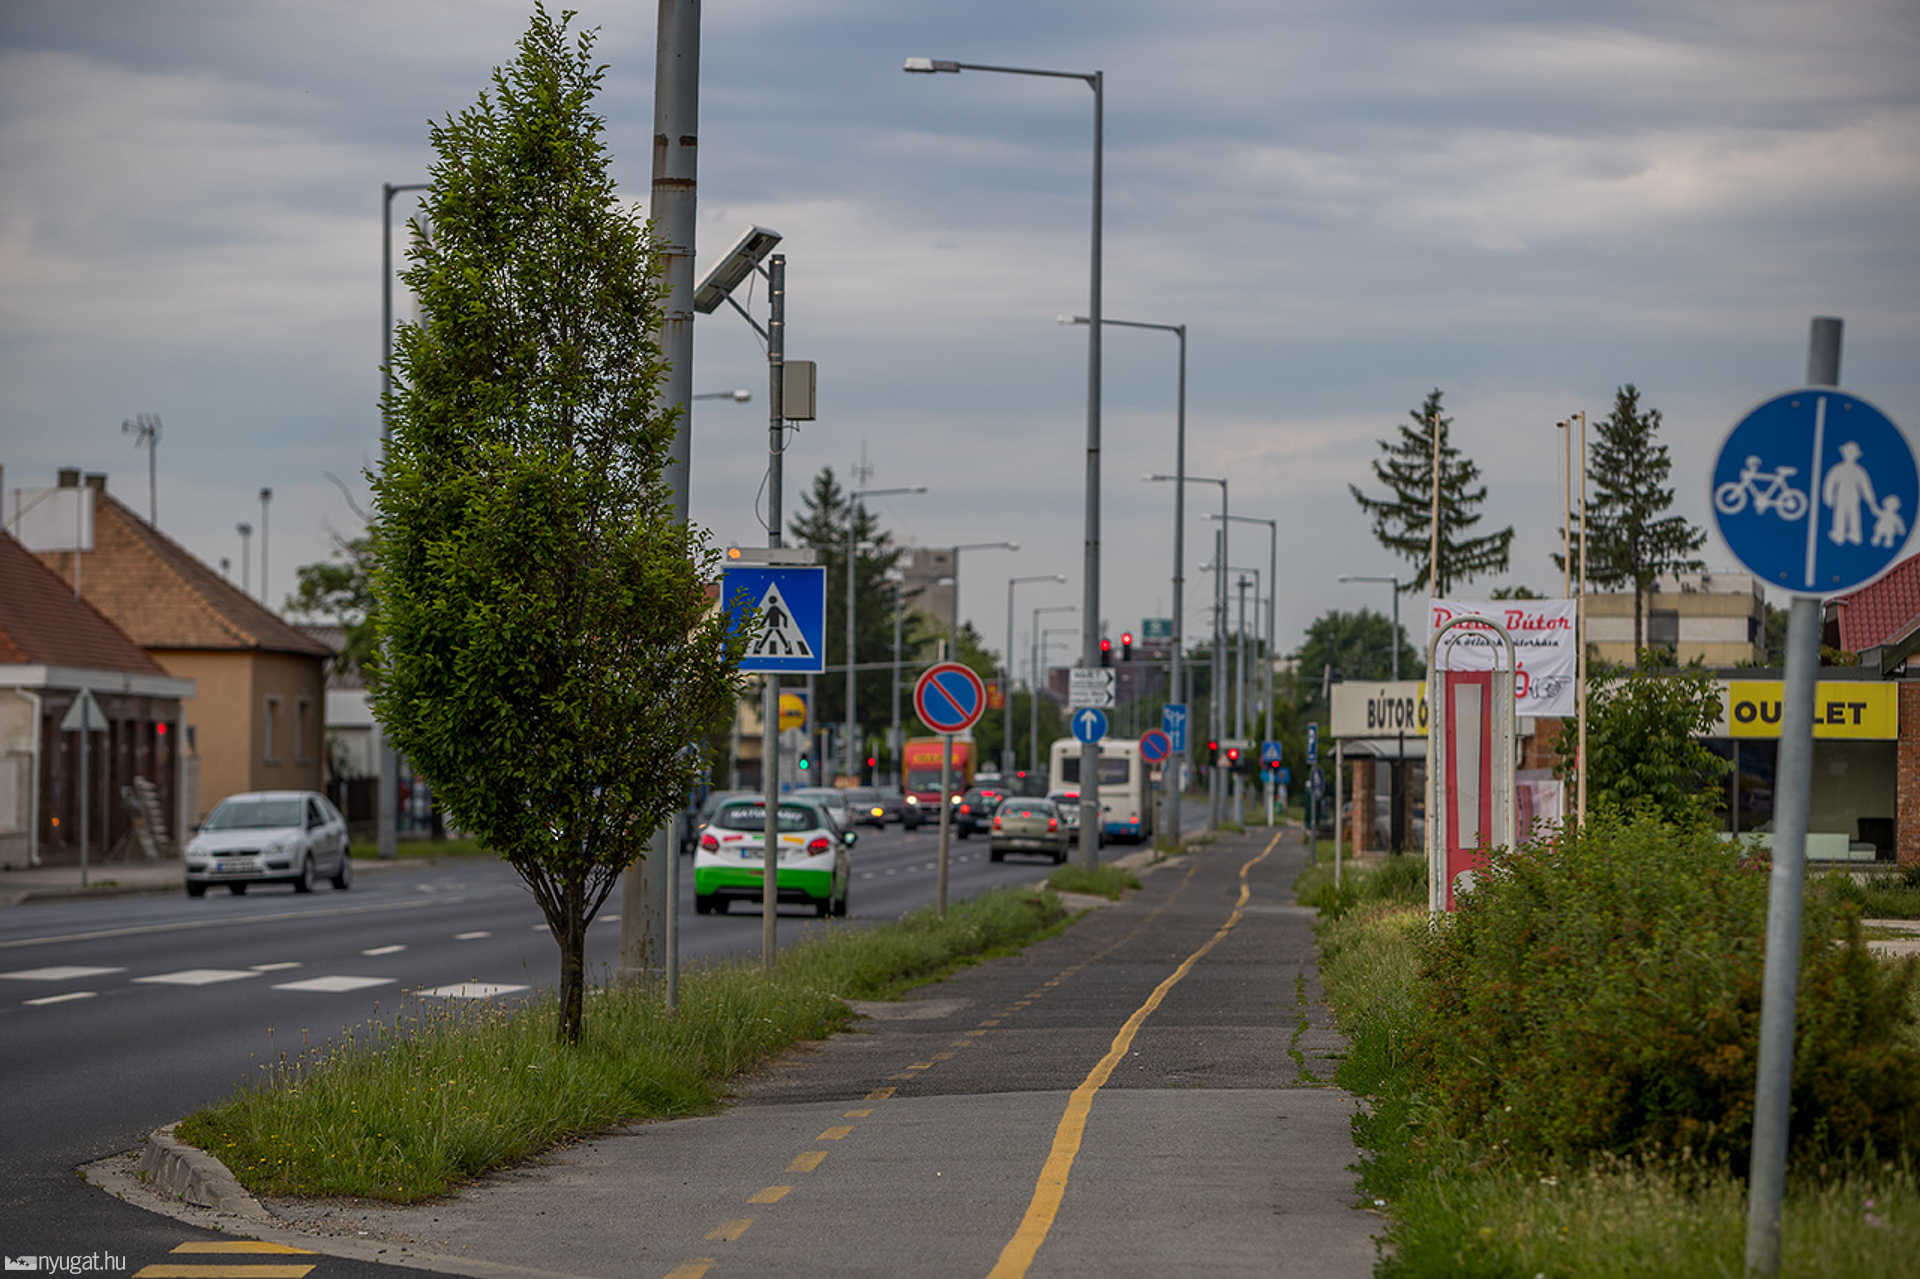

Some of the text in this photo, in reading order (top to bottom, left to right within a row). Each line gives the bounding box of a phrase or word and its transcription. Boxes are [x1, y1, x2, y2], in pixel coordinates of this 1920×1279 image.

[1504, 609, 1571, 630] Bútor
[1368, 688, 1414, 728] BÚTOR
[1734, 701, 1867, 725] OULET
